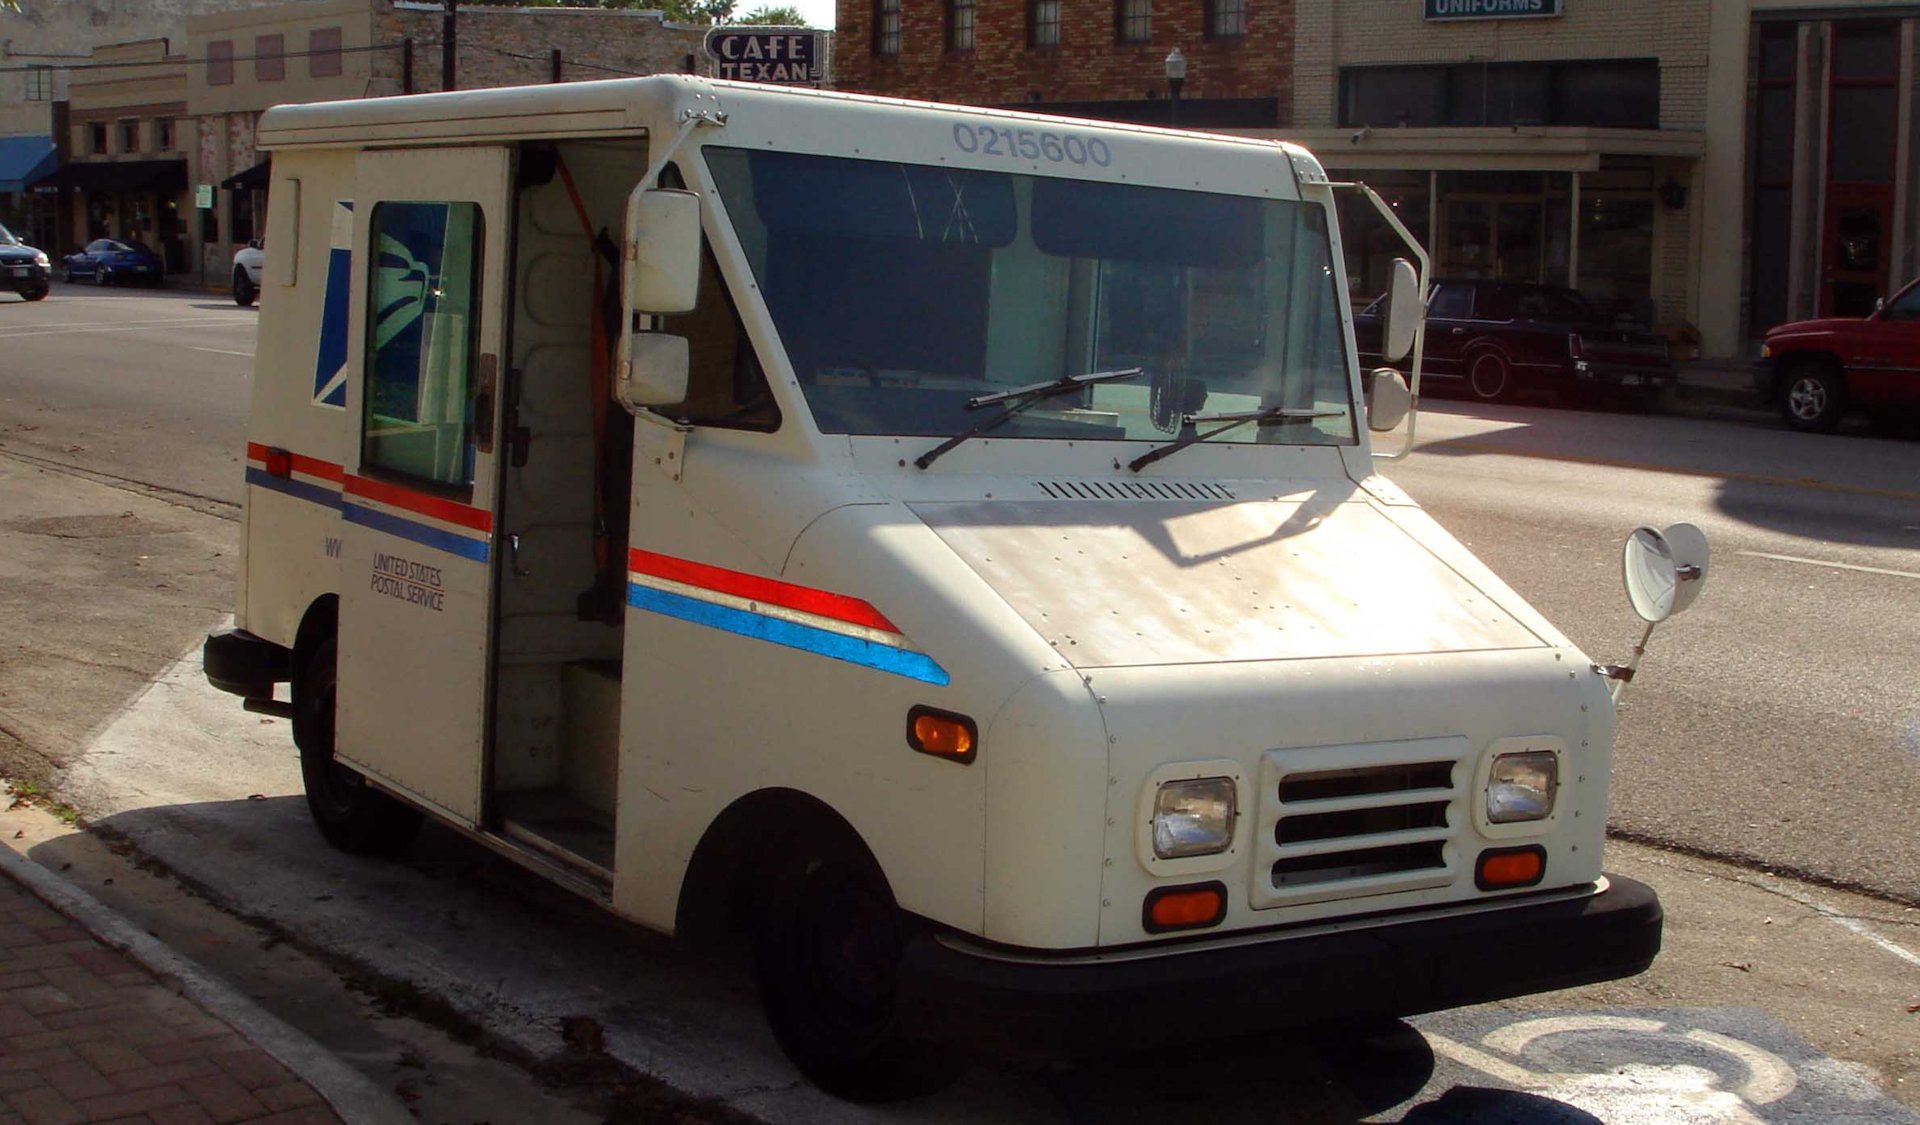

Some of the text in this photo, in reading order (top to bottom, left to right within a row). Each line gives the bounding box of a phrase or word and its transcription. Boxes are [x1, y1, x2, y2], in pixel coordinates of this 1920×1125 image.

[1435, 0, 1542, 13] UNIFORMS
[721, 36, 805, 59] CAFE
[721, 62, 808, 81] TEXAN
[953, 123, 1111, 167] 0215600
[373, 552, 442, 586] UNITED STATES
[370, 573, 444, 611] POSTAL SERVICE
